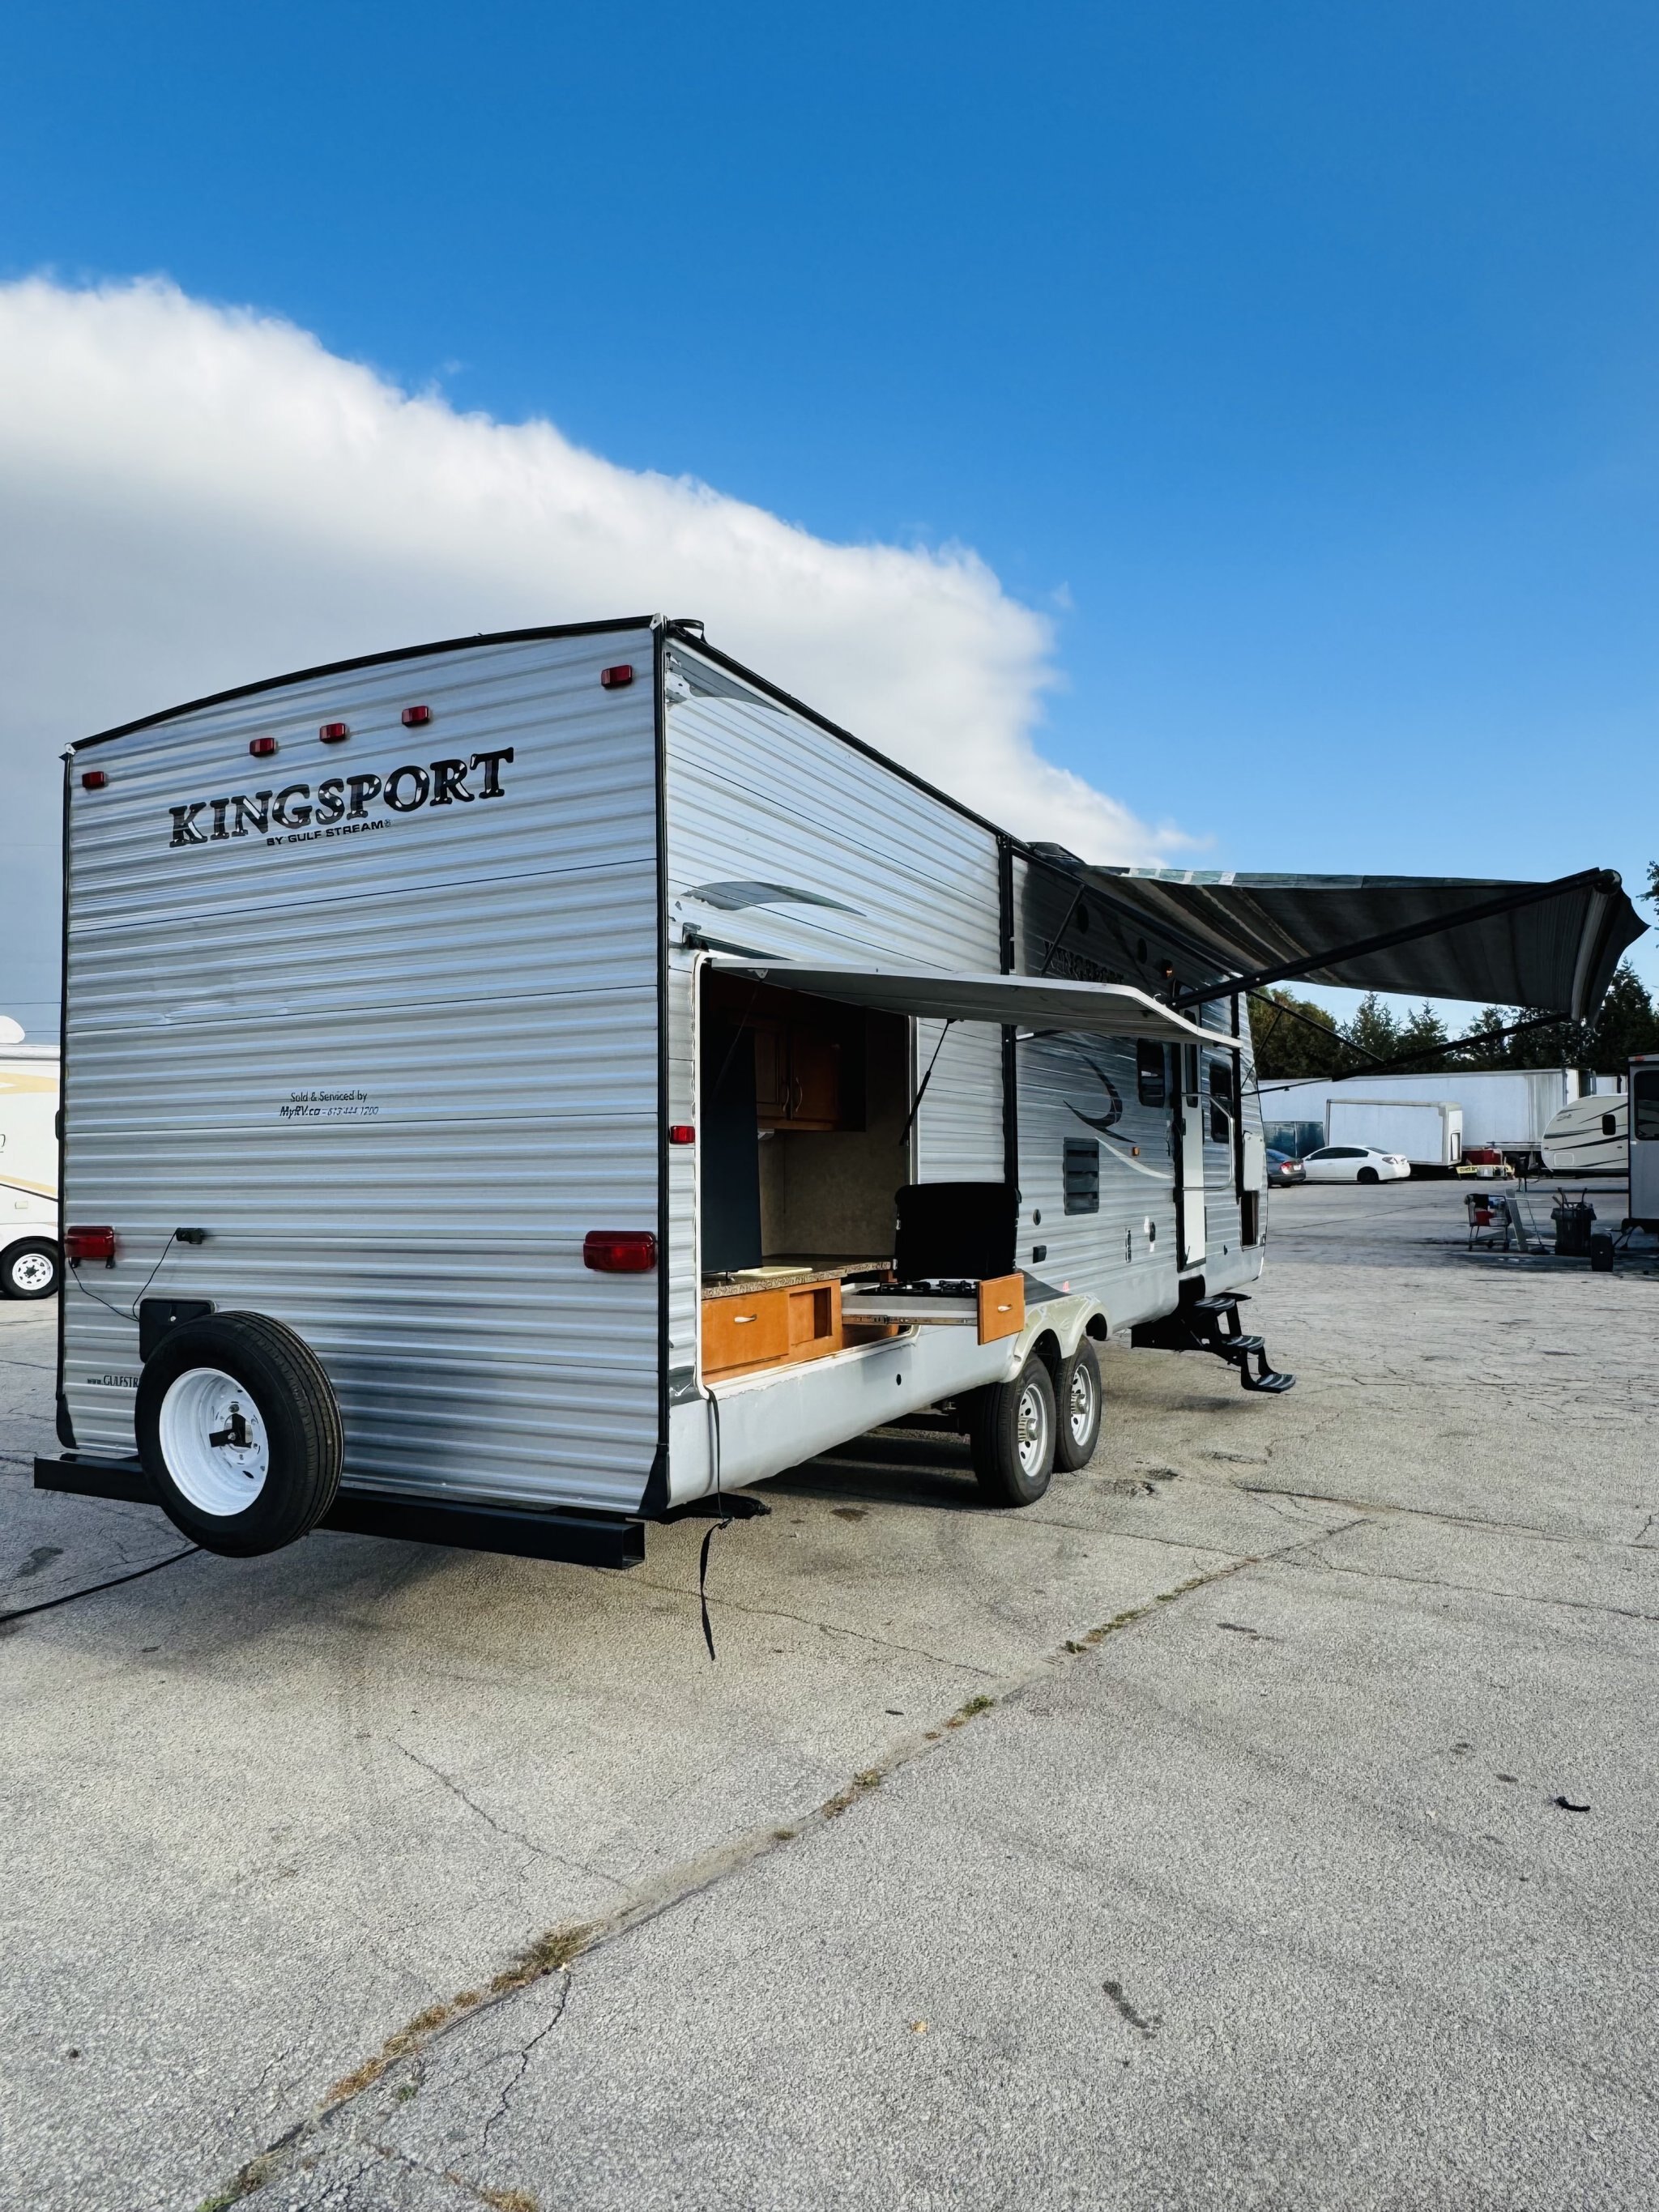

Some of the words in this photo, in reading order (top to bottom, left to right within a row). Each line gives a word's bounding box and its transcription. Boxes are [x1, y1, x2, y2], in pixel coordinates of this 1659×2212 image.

[168, 747, 514, 848] KINGSPORT
[267, 837, 284, 846] BY
[288, 830, 322, 843] GULF
[291, 1091, 308, 1102] Sold
[311, 1092, 317, 1102] &
[357, 1089, 368, 1102] by
